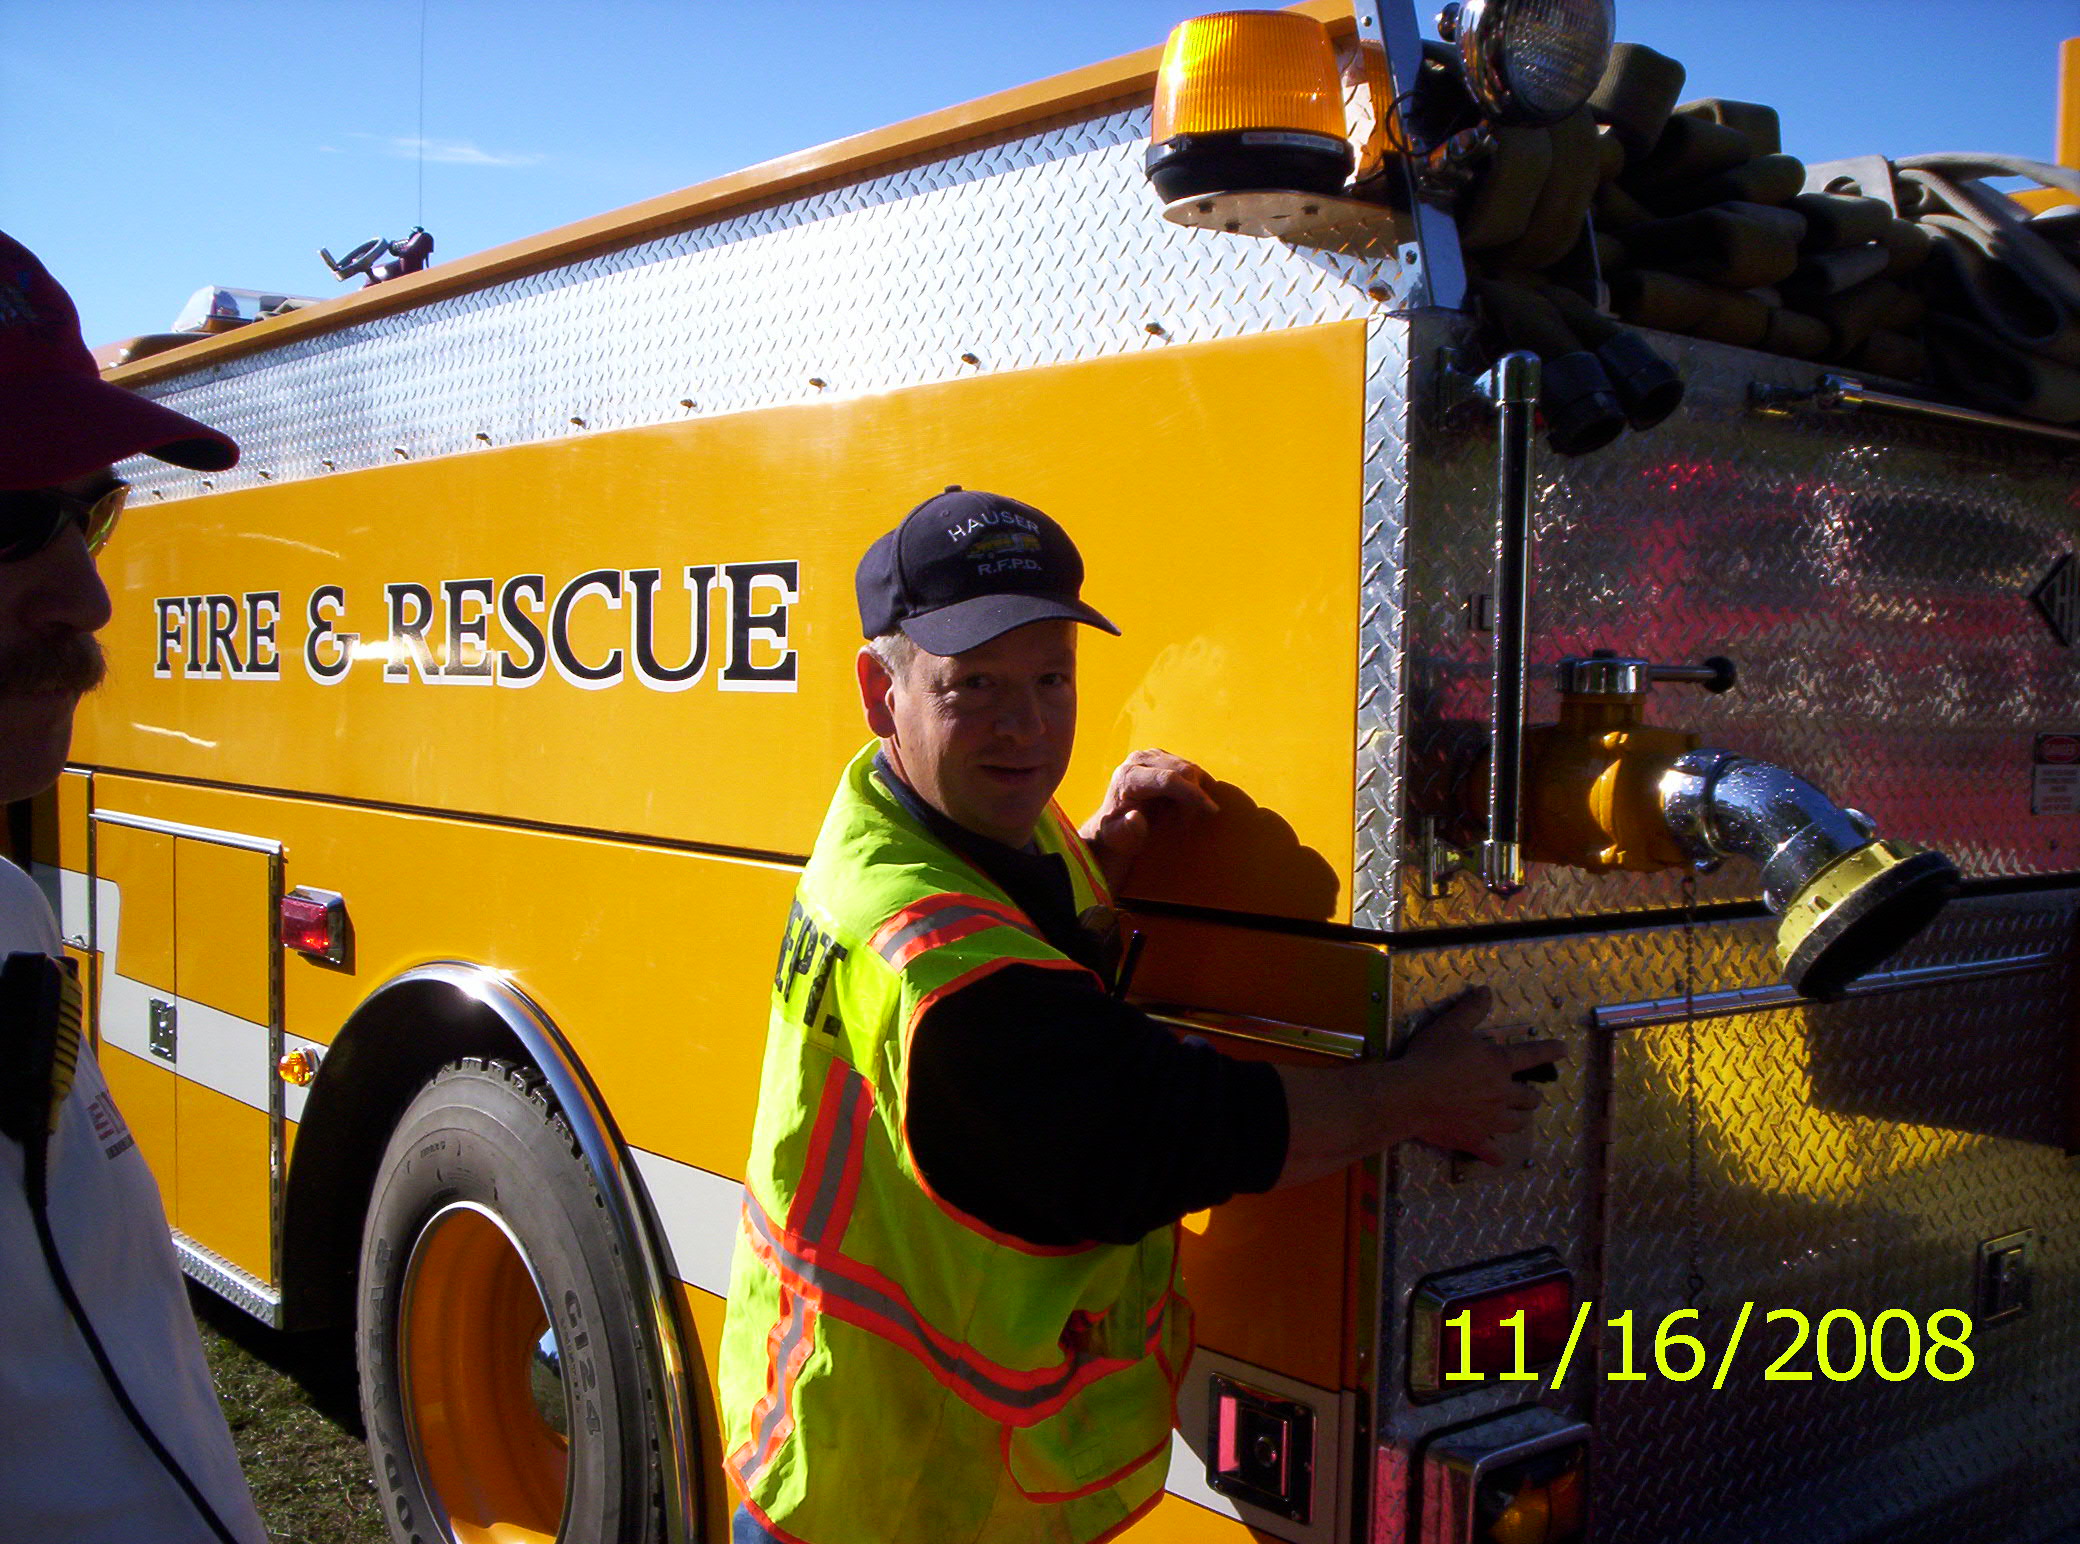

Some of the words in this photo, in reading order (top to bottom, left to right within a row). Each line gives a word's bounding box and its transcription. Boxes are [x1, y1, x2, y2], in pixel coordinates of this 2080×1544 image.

[946, 509, 1041, 543] HAUSER
[154, 590, 280, 681] FIRE
[304, 585, 360, 686] &
[383, 559, 799, 694] RESCUE
